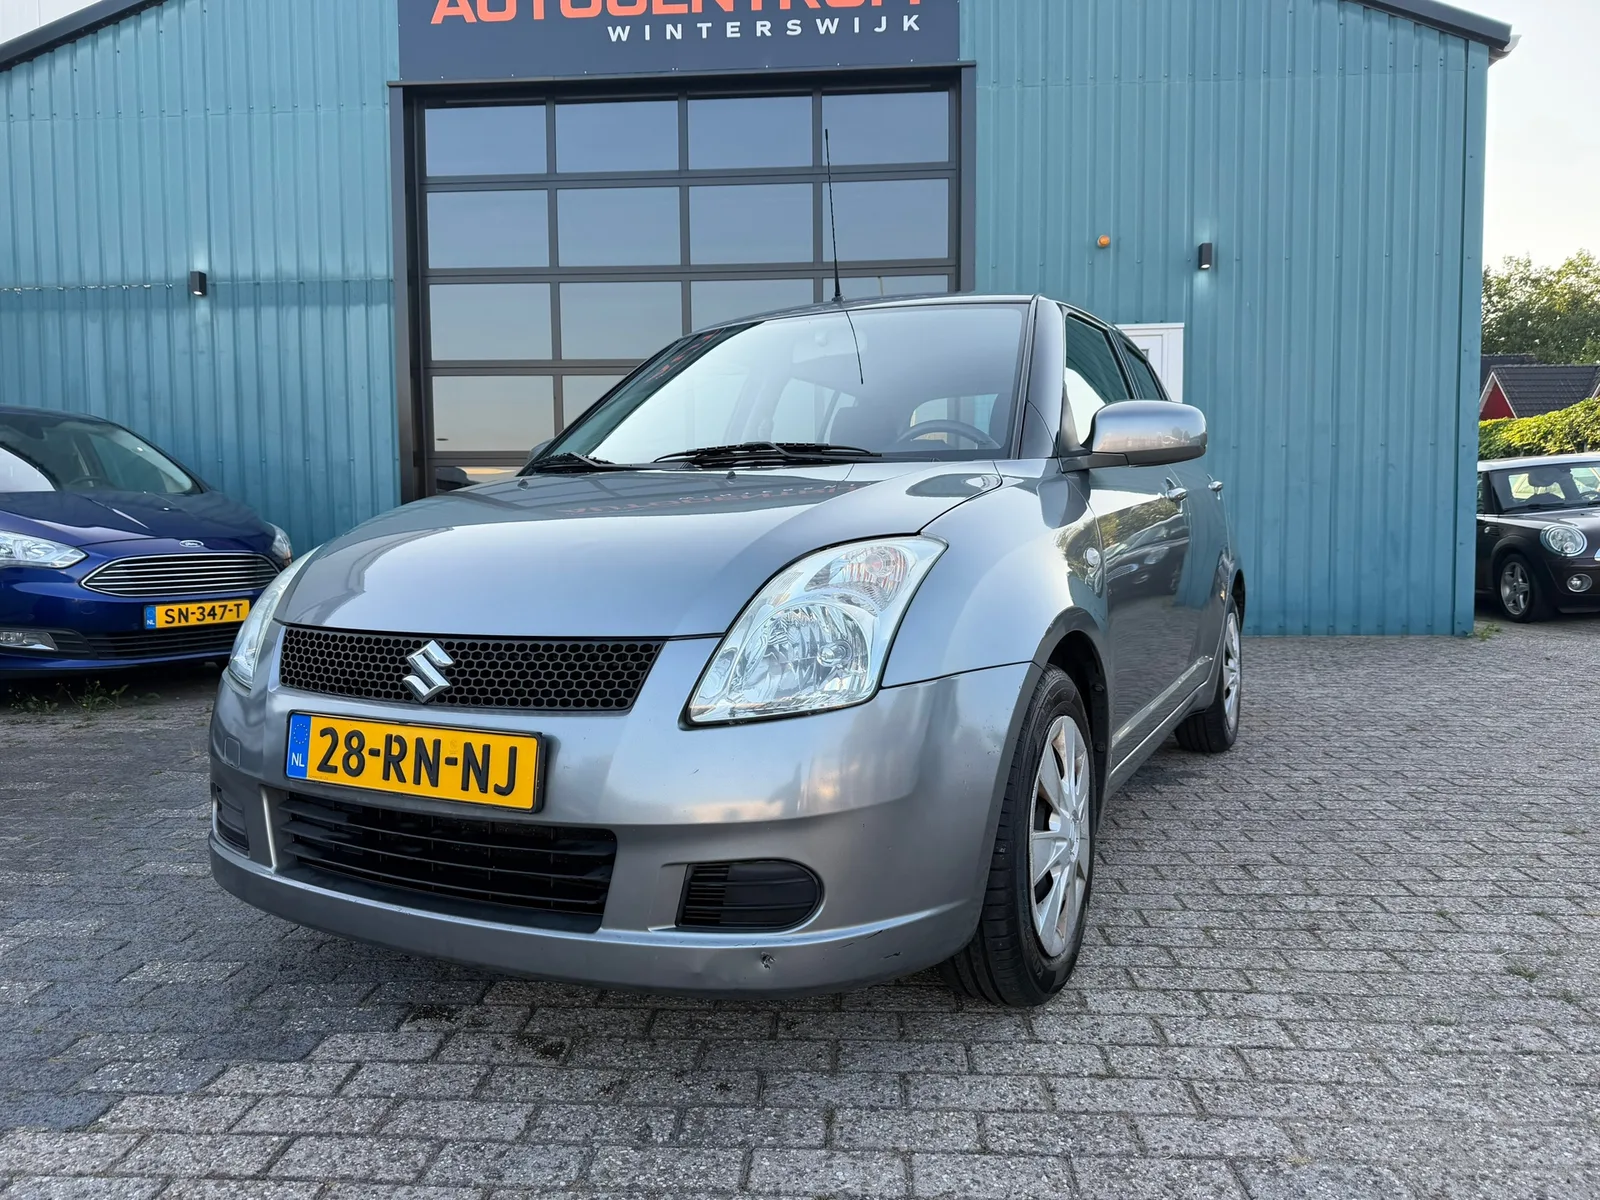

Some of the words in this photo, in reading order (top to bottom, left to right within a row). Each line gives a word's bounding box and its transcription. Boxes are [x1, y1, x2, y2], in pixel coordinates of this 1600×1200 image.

[607, 14, 920, 42] WINTERSWIJK
[164, 603, 243, 624] SN-347-T
[291, 752, 305, 768] NL
[316, 726, 518, 797] 28-RN-NJ
